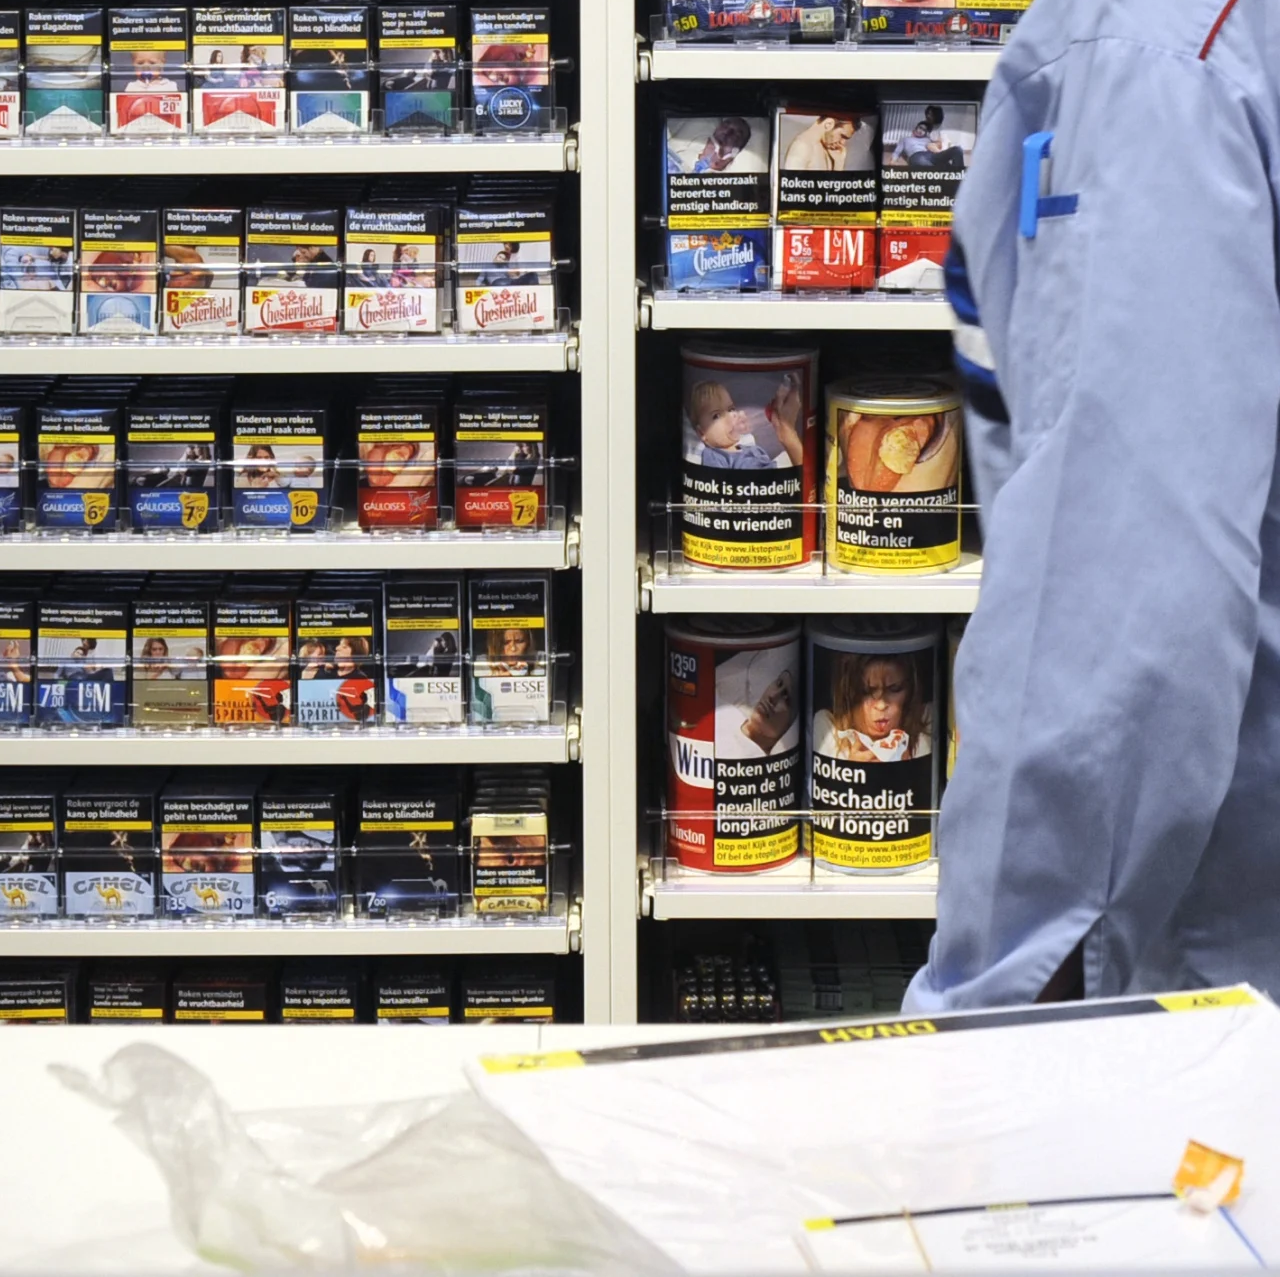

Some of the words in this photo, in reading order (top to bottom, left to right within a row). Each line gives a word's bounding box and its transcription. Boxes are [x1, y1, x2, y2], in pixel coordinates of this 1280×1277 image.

[222, 13, 271, 23] vermindert
[670, 176, 700, 186] Roken
[702, 175, 758, 187] veroorzaakt
[781, 177, 814, 188] Roken
[817, 178, 863, 191] vergroot
[865, 178, 876, 188] de
[670, 189, 717, 199] beroertes
[719, 189, 731, 198] en
[780, 192, 806, 203] kans
[808, 192, 823, 204] op
[670, 201, 710, 212] ernstige
[712, 200, 759, 212] handicaps
[823, 229, 864, 266] L&M
[693, 241, 754, 275] Chesterfield
[475, 293, 538, 328] Chesterfield
[694, 477, 719, 495] rook
[722, 479, 734, 495] is
[736, 479, 801, 497] schadelijk
[714, 517, 730, 530] en
[733, 515, 792, 532] vrienden
[838, 512, 880, 528] mond-
[883, 515, 902, 529] en
[837, 530, 914, 549] keelkanker
[427, 681, 459, 694] ESSE
[78, 682, 111, 713] L&M
[301, 707, 341, 722] SPIRIT
[717, 763, 763, 778] Roken
[813, 755, 867, 784] Roken
[717, 782, 727, 796] 9
[730, 781, 757, 796] van
[760, 778, 776, 794] de
[779, 774, 791, 789] 10
[813, 780, 914, 813] beschadigt
[839, 814, 909, 840] longen
[717, 841, 735, 853] Stop
